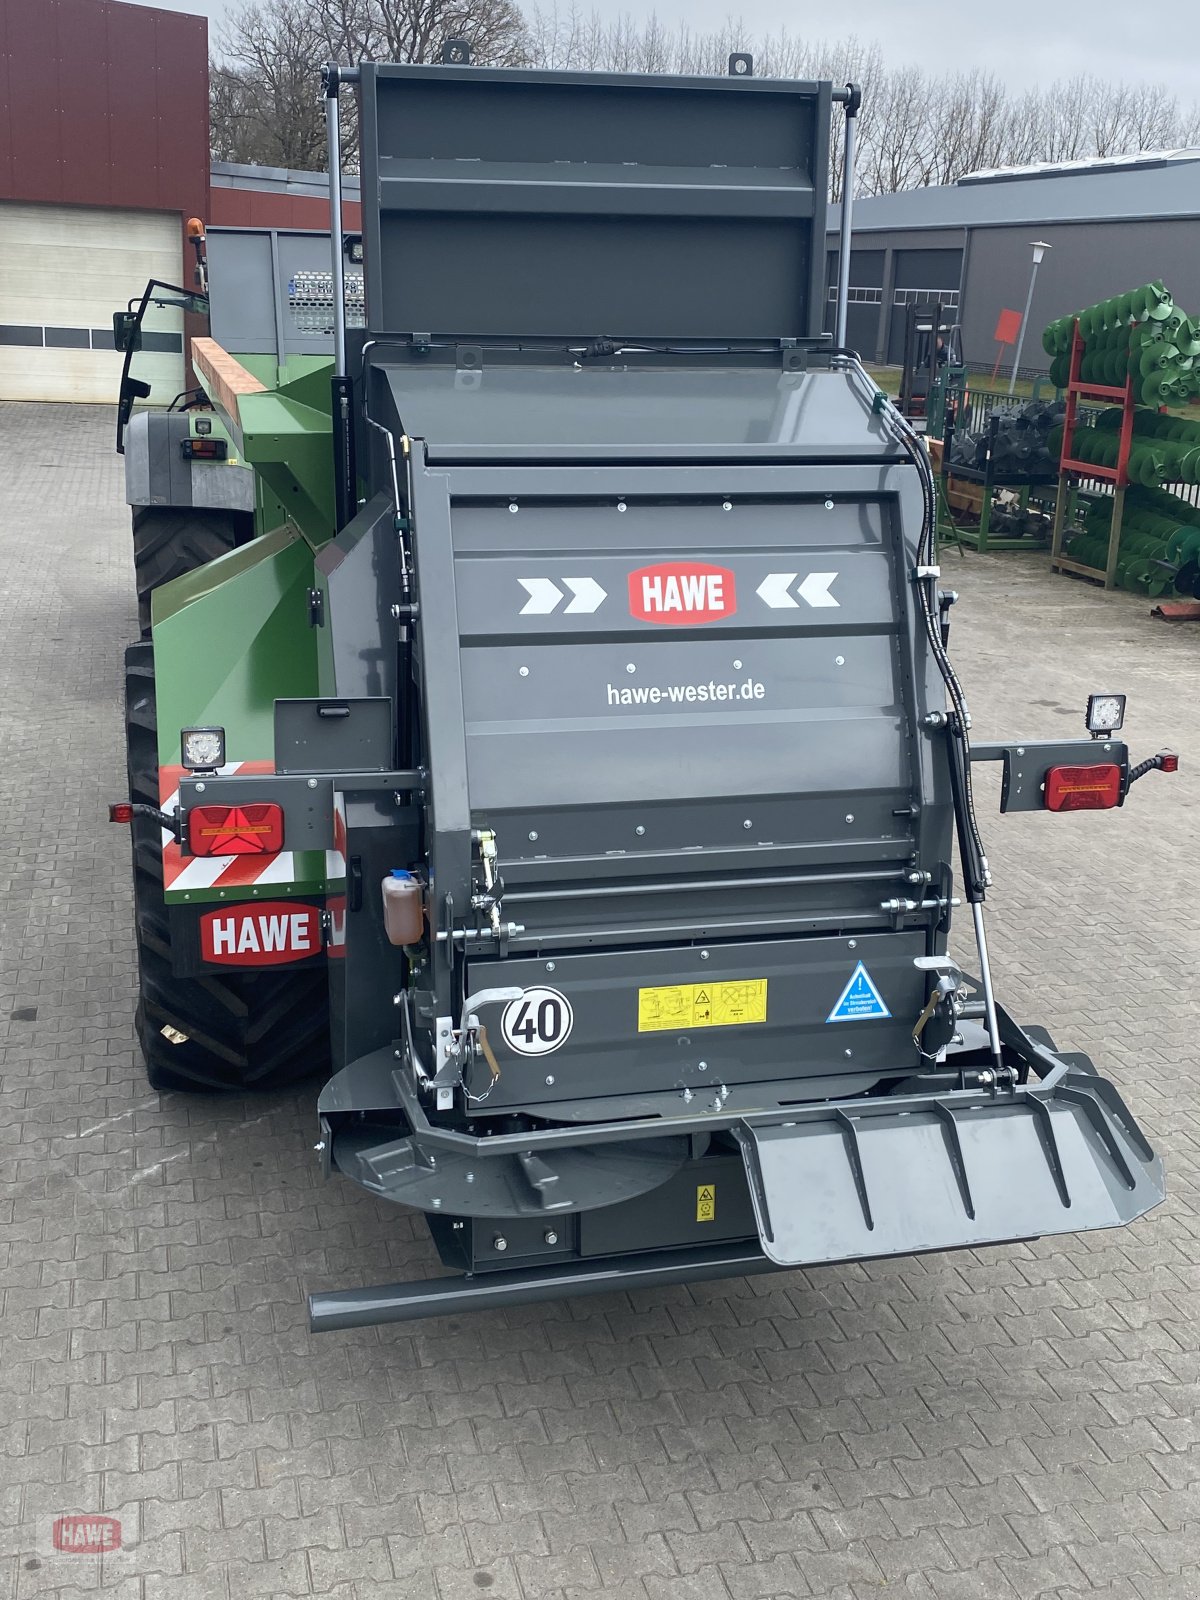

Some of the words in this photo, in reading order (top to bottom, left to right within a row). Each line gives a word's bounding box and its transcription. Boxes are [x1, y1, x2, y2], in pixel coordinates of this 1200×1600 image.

[642, 575, 724, 612] HAWE
[606, 678, 766, 705] hawe-wester.de
[212, 913, 310, 955] HAWE
[511, 999, 562, 1043] 40
